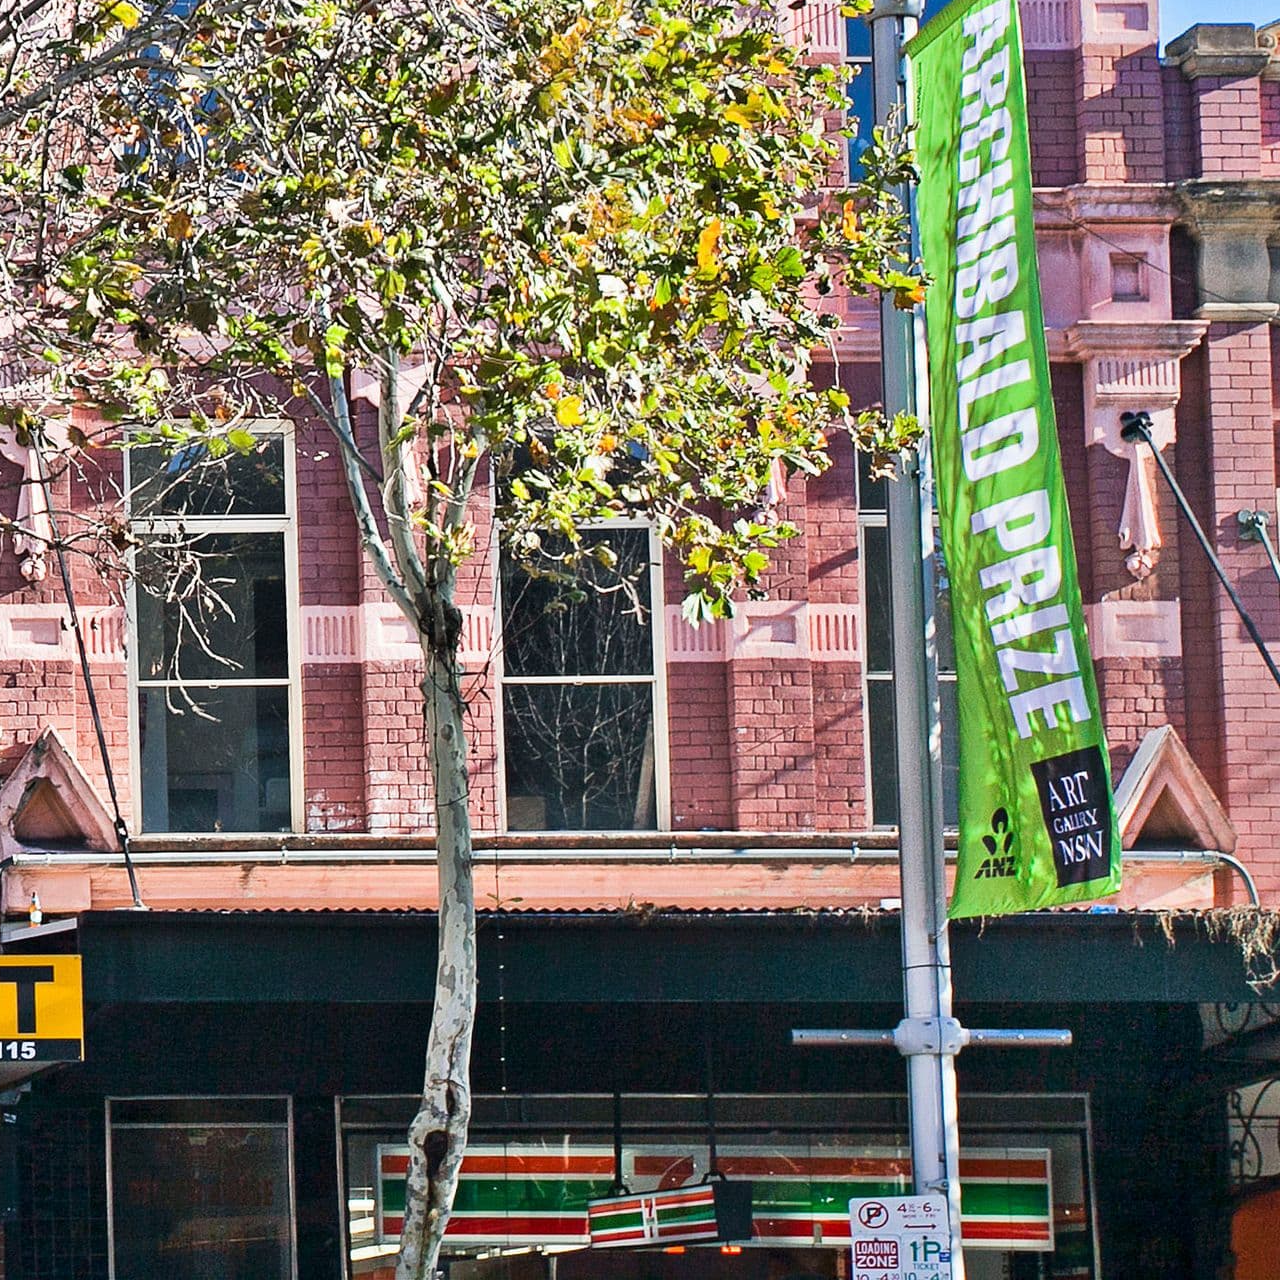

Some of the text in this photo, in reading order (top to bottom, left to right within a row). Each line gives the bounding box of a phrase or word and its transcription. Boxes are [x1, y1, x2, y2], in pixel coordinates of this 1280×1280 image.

[971, 488, 1091, 739] PRIZE
[1048, 771, 1088, 812] ART
[1059, 830, 1103, 865] NSW
[974, 856, 1015, 880] ANZ
[856, 1243, 896, 1254] LOADING
[910, 1241, 941, 1262] 1P
[856, 1255, 897, 1268] ZONE
